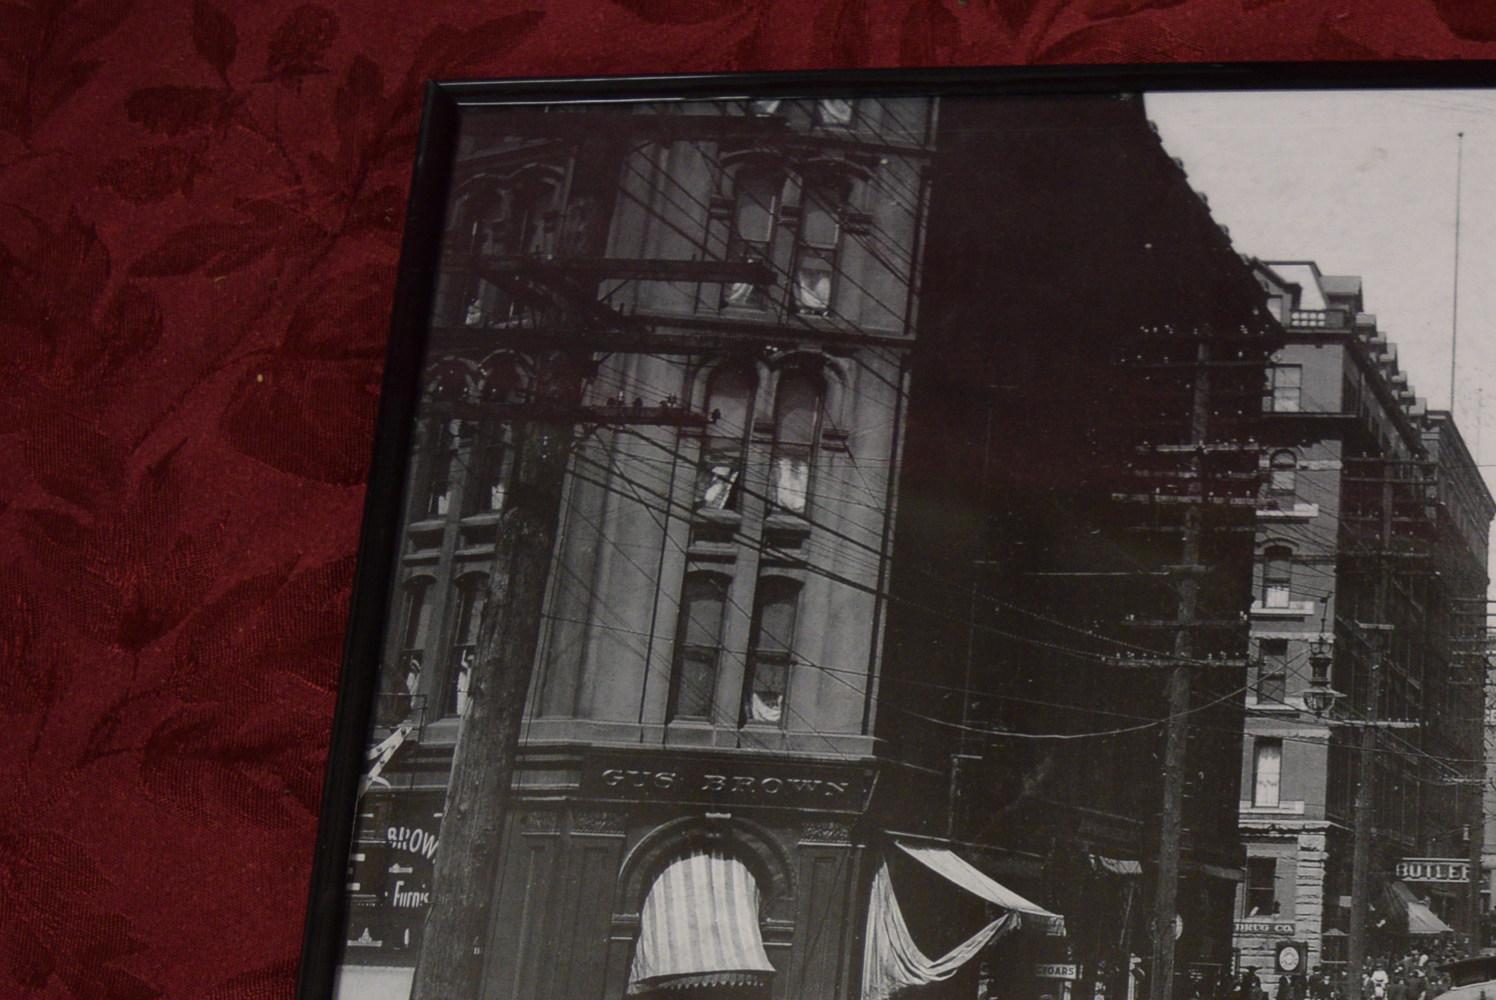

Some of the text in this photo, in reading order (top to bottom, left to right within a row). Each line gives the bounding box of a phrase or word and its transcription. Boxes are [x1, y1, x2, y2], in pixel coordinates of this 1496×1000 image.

[601, 768, 849, 796] GUS BROWN
[387, 826, 440, 860] BROW
